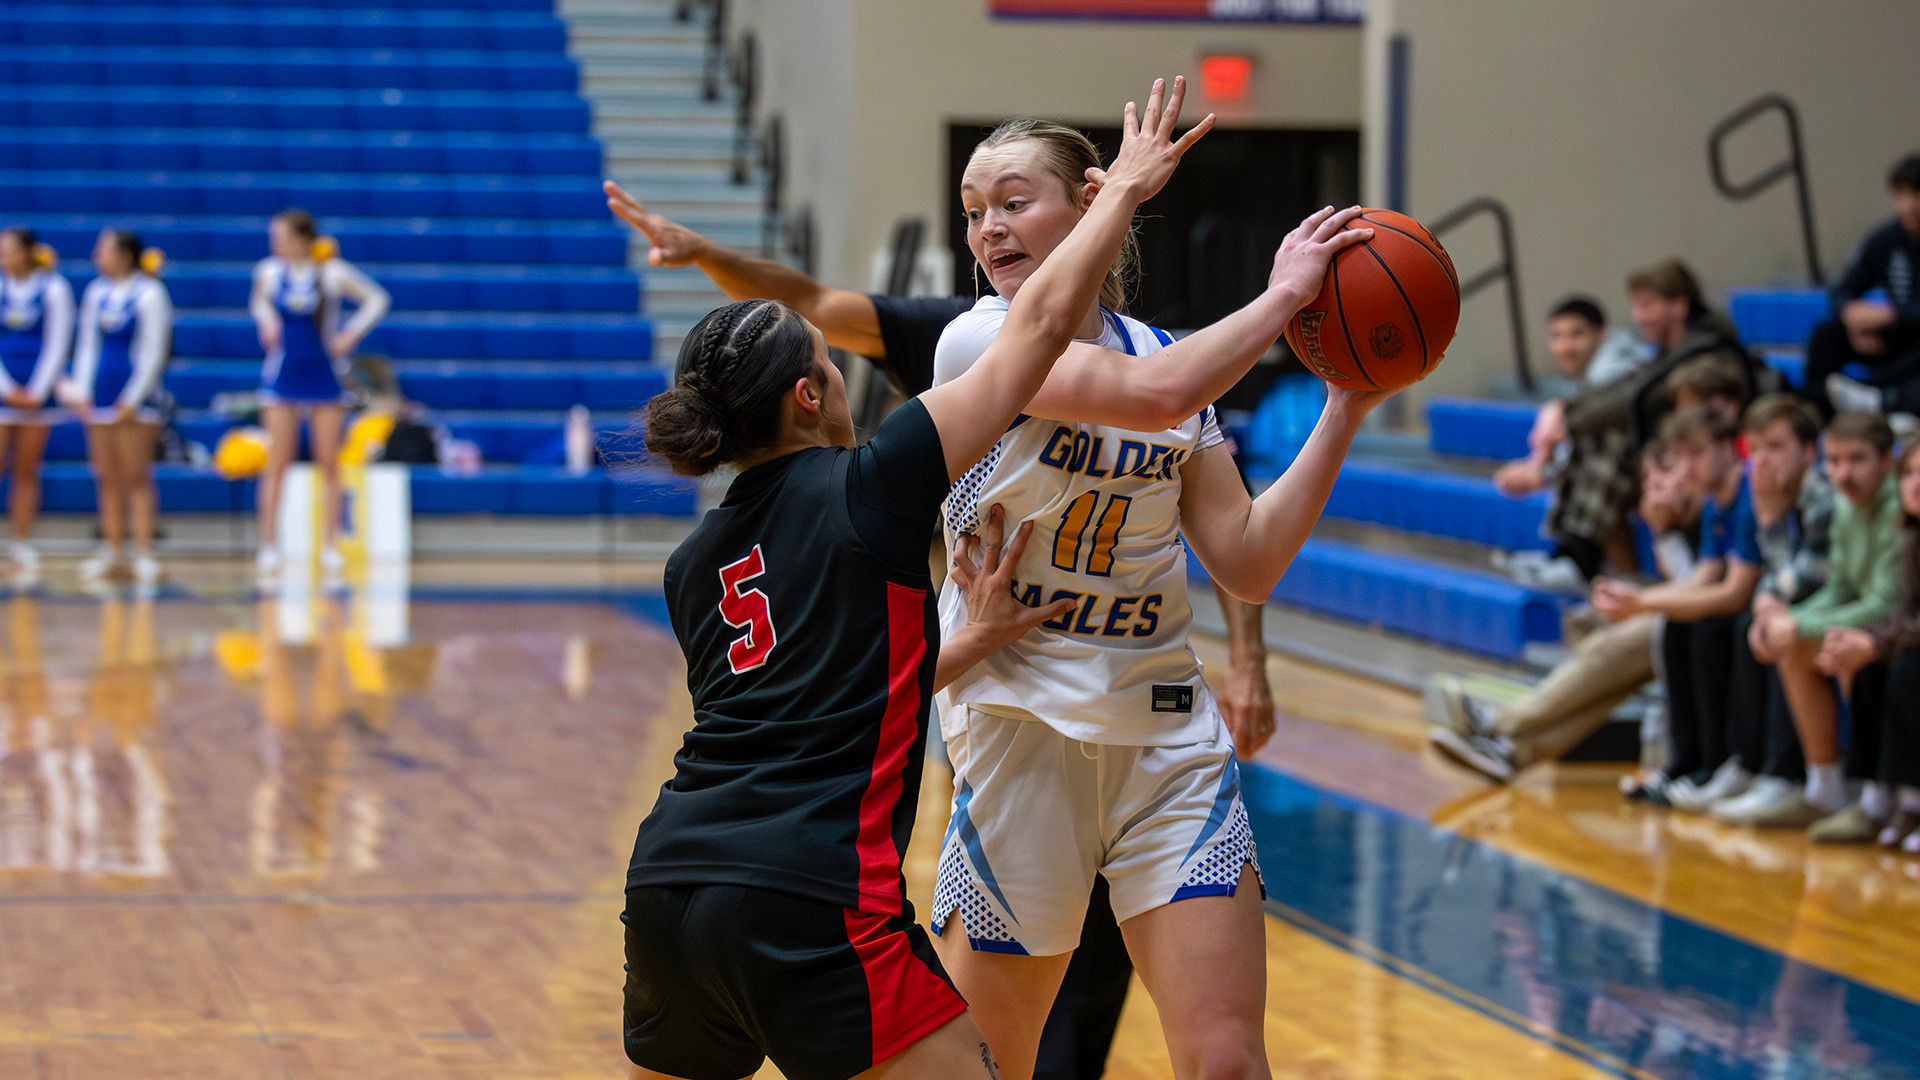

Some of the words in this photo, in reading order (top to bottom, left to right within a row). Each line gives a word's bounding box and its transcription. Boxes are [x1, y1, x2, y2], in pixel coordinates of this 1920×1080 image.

[1038, 425, 1187, 480] GOLDEN
[1051, 490, 1133, 577] 11
[719, 543, 777, 675] 5
[1011, 580, 1163, 639] AGLES
[1181, 693, 1190, 705] M
